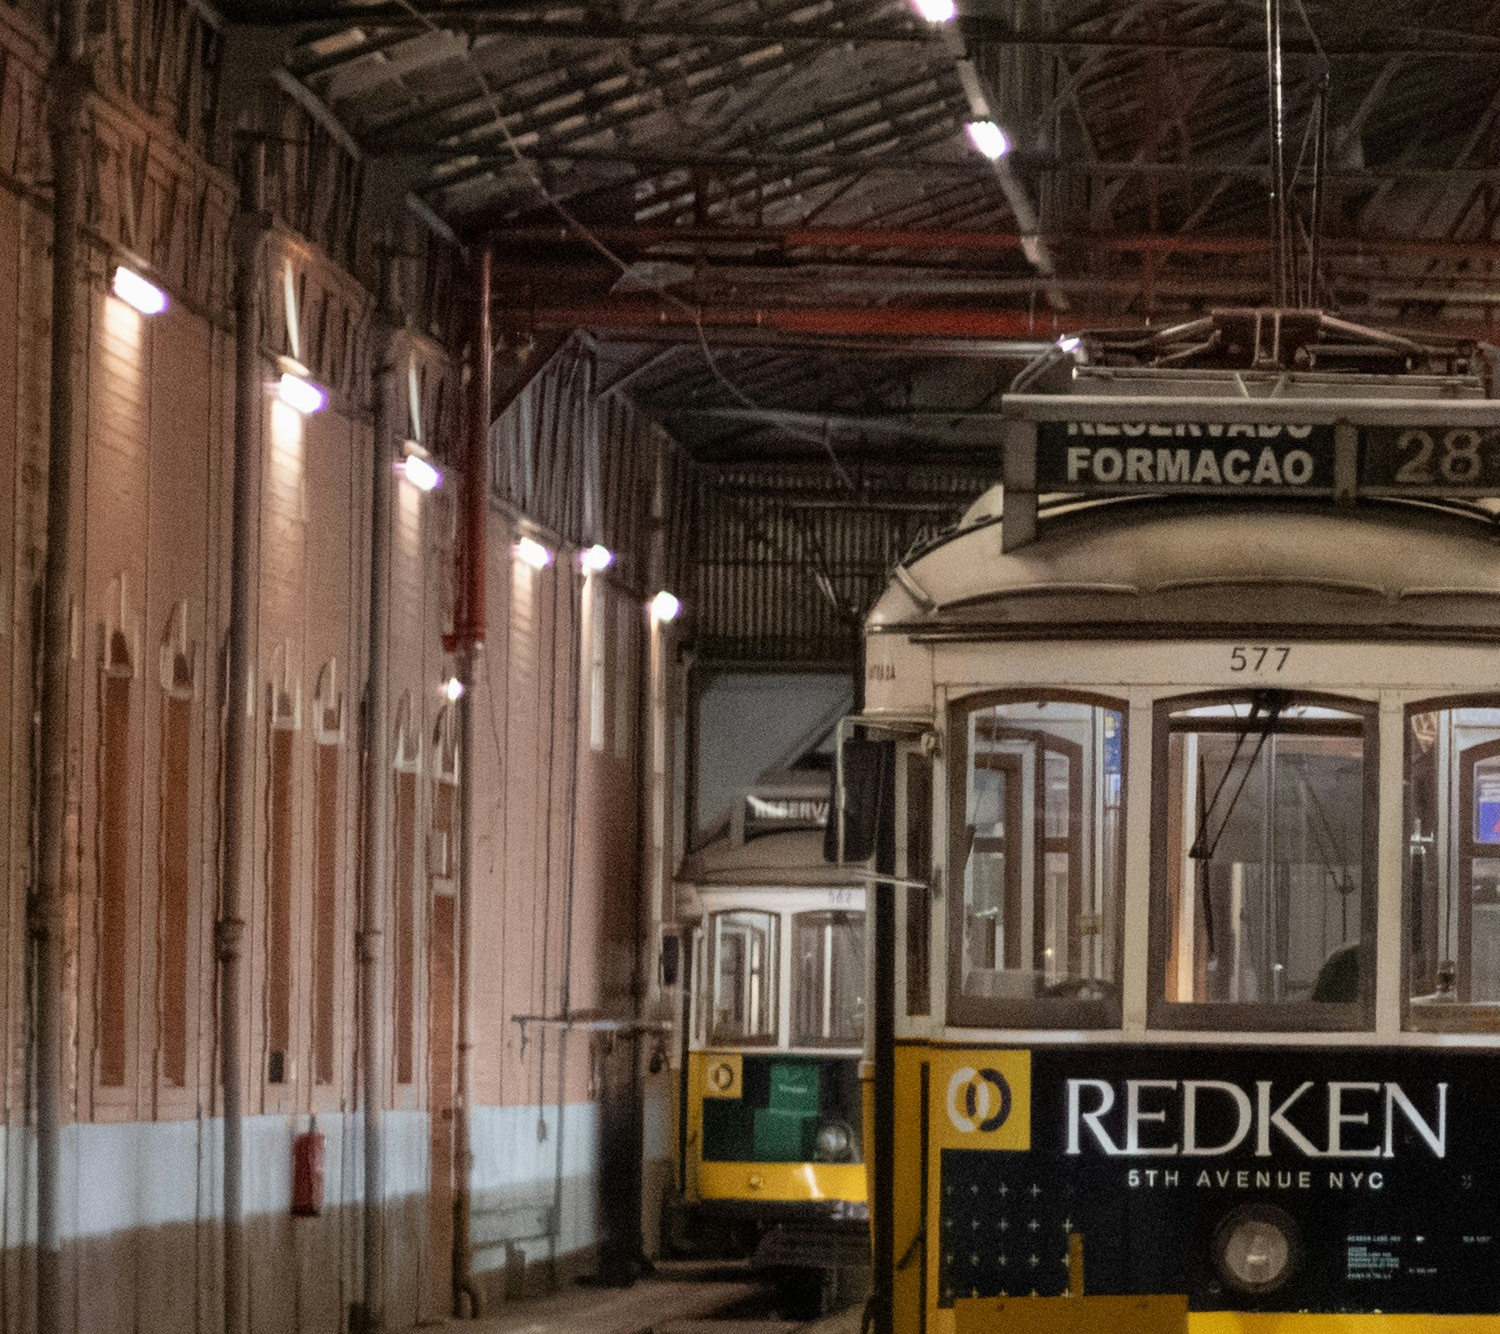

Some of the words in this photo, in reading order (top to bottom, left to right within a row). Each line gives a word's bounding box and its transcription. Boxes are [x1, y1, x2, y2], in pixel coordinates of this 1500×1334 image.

[1394, 429, 1484, 483] 28
[1230, 648, 1291, 673] 577
[1065, 1078, 1449, 1159] REDKEN
[1128, 1170, 1180, 1188] 5TH
[1196, 1170, 1311, 1189] AVENUE
[1328, 1171, 1385, 1189] NYC
